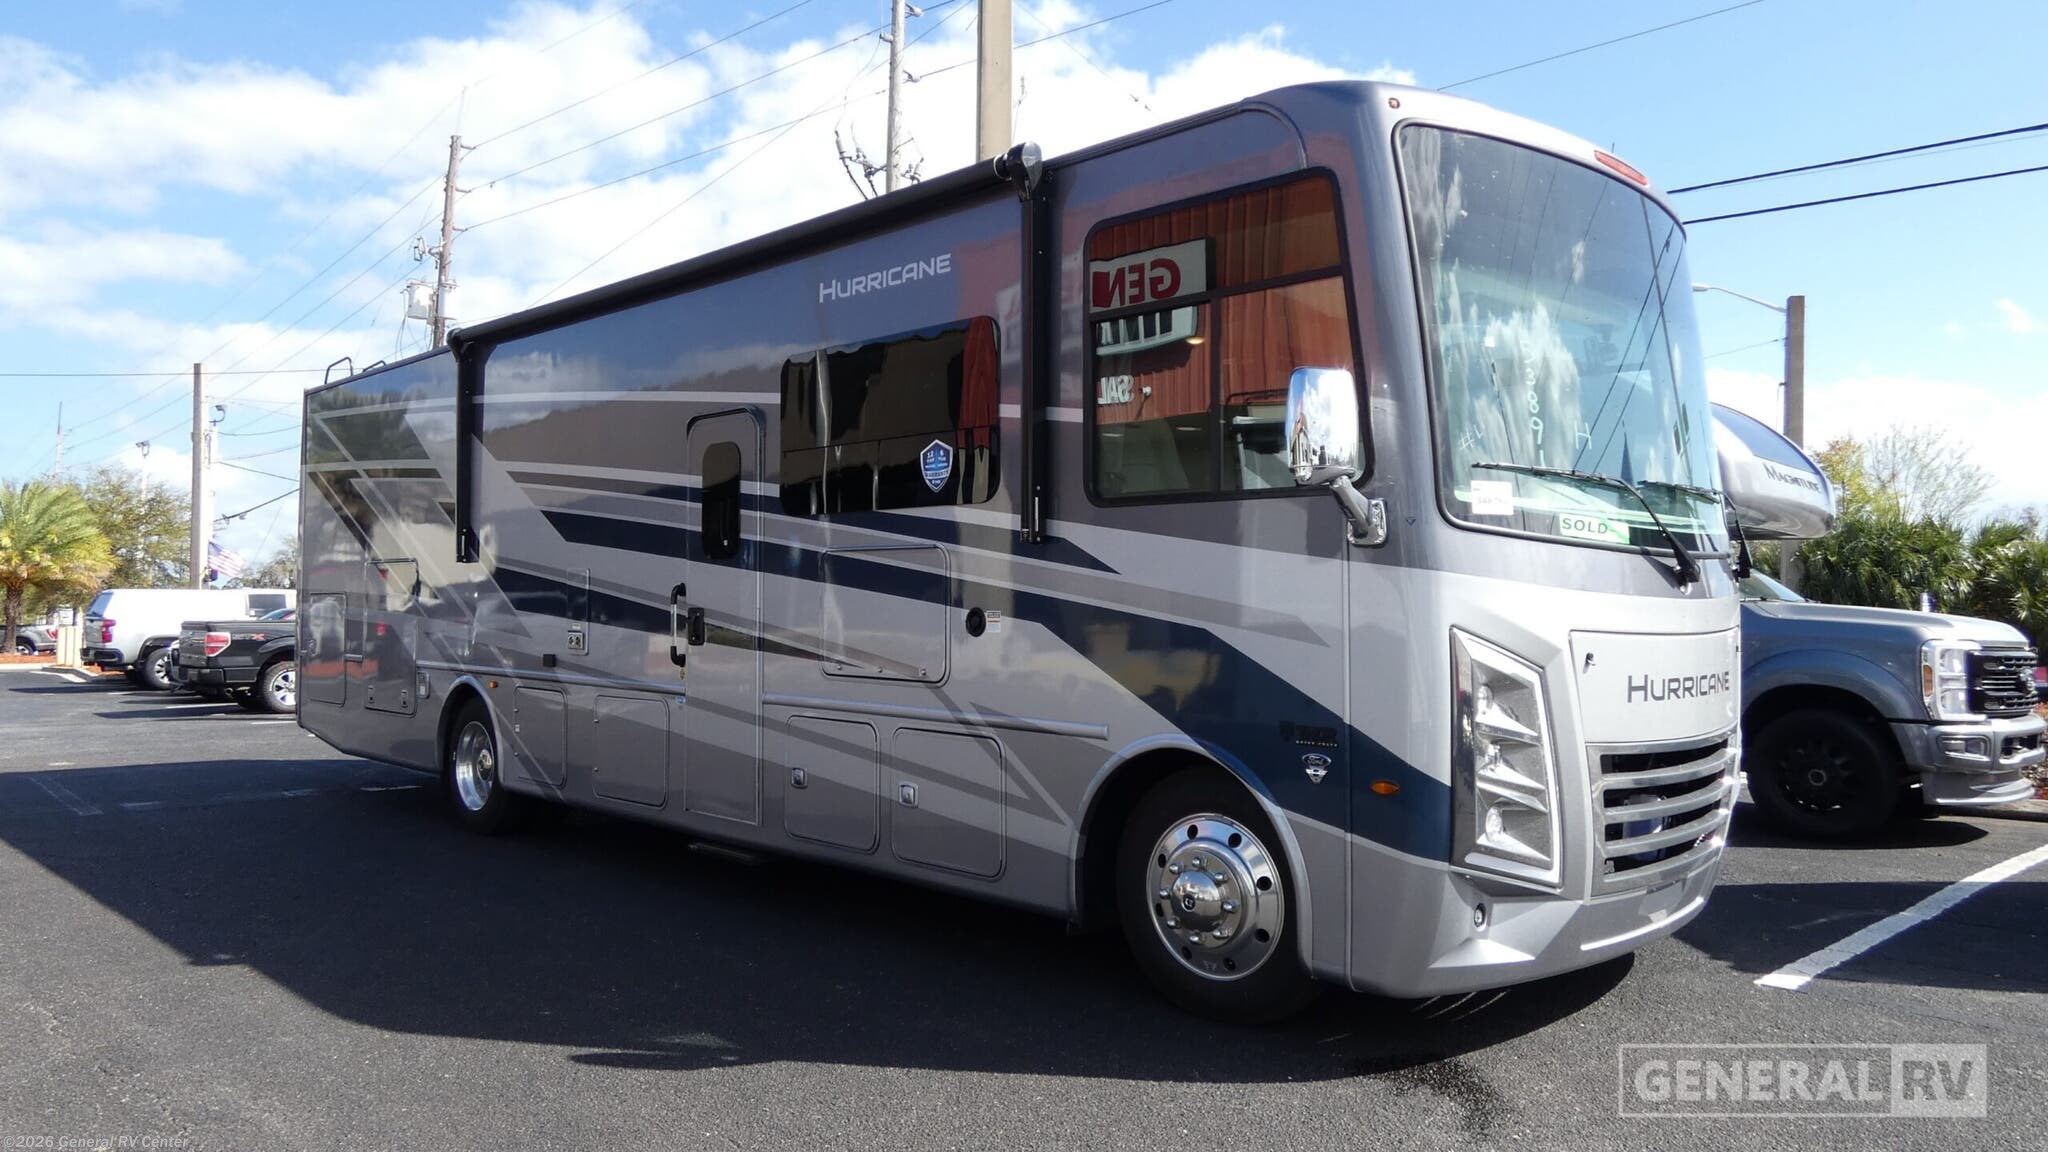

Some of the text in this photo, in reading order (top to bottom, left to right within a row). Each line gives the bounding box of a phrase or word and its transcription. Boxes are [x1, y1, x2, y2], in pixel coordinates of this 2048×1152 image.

[819, 252, 952, 303] HURRICANE
[1562, 517, 1608, 534] SOLD
[1627, 671, 1730, 703] HURRICANE
